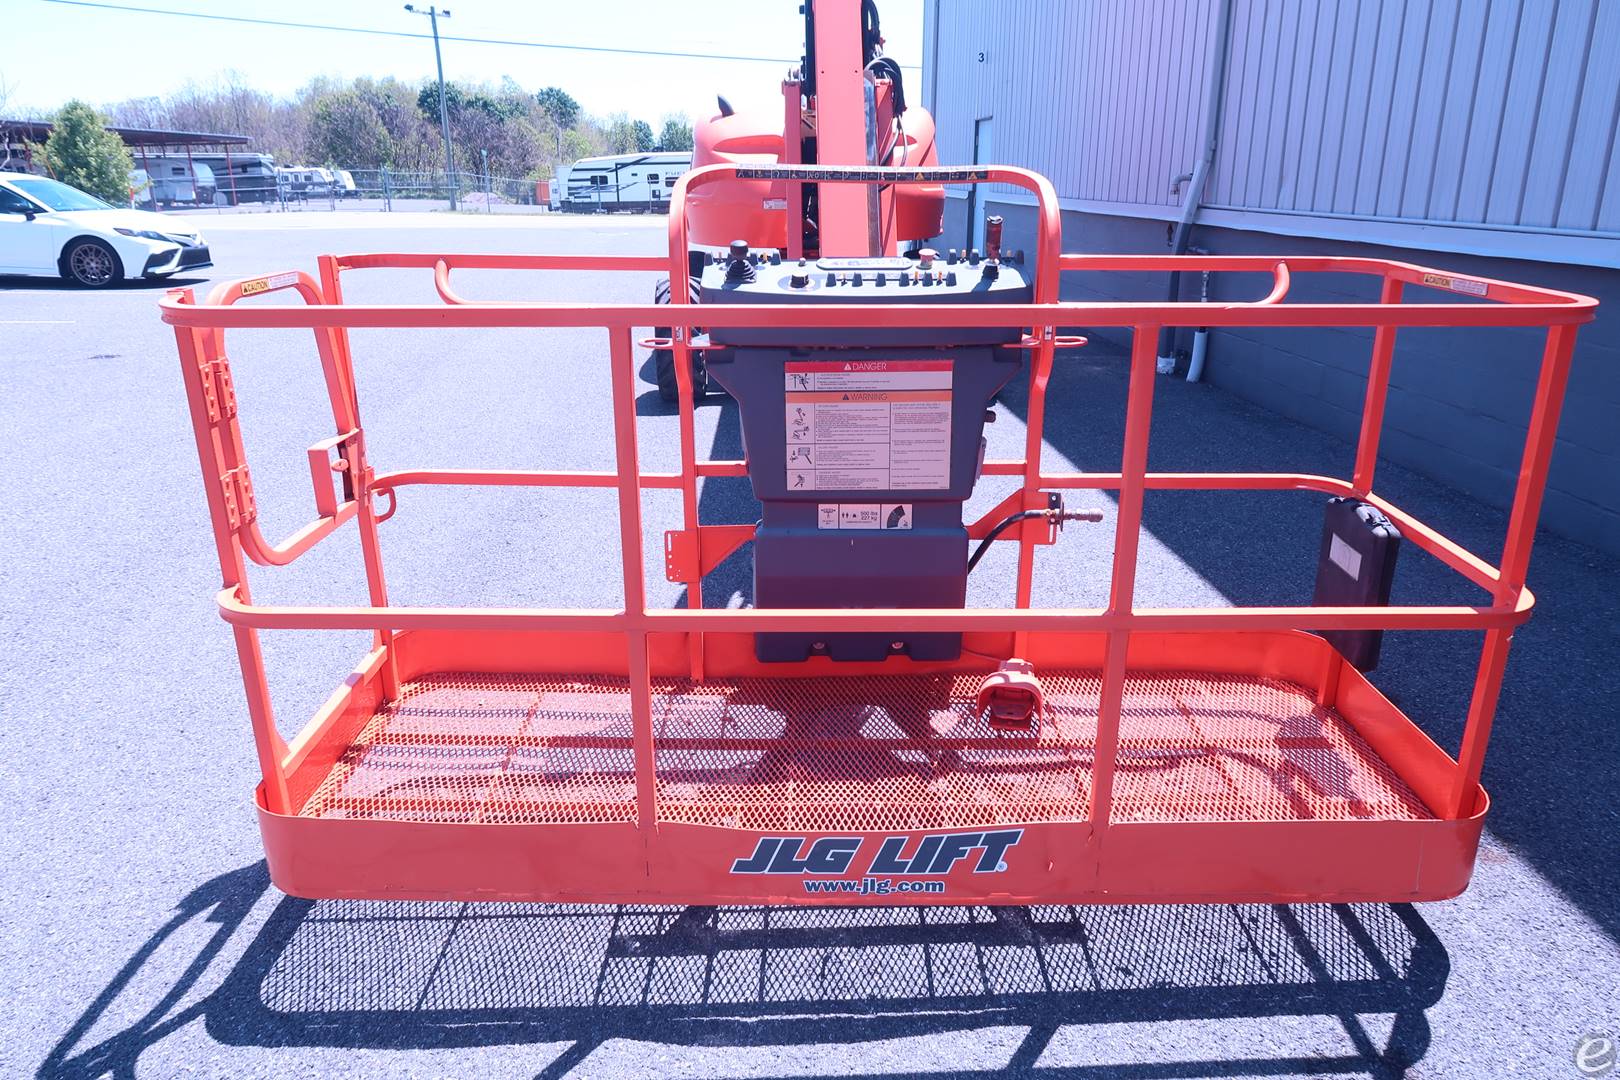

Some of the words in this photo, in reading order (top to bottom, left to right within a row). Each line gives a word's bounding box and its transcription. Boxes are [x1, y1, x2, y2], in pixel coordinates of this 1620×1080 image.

[978, 52, 985, 63] 3
[247, 279, 269, 292] CAUTION
[852, 362, 887, 371] DANGER
[850, 393, 888, 401] WARNING
[729, 836, 864, 875] JLG
[803, 877, 945, 895] www.jlg.com
